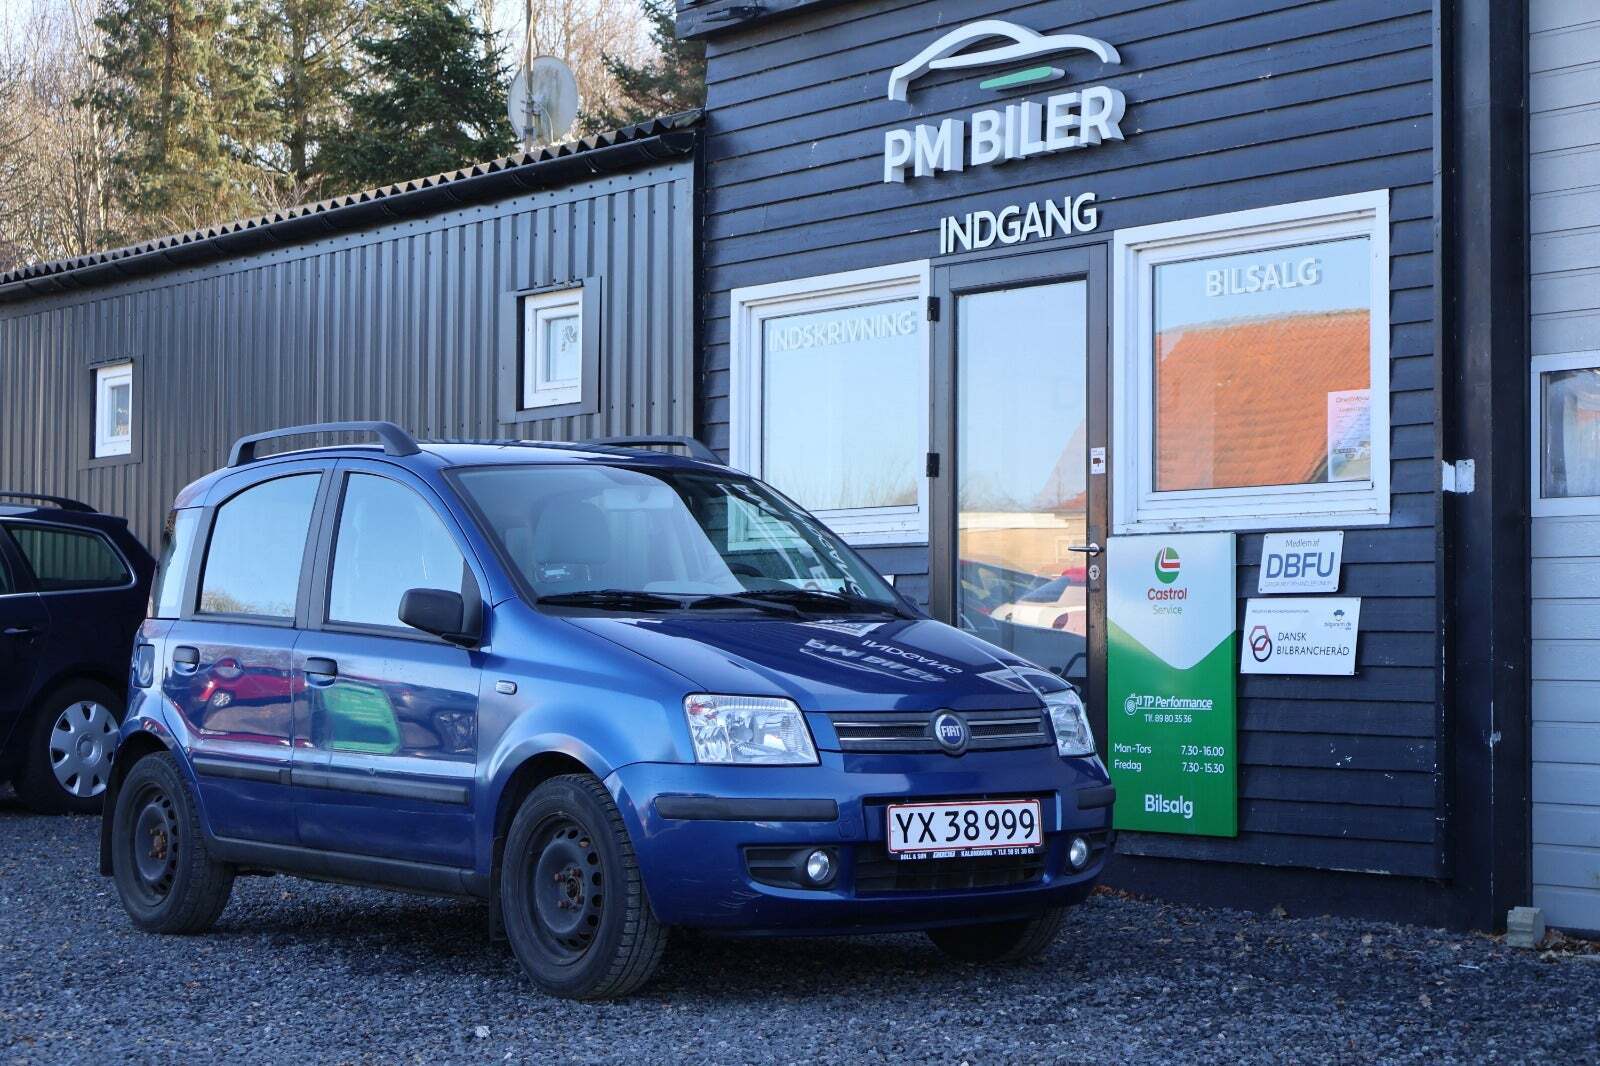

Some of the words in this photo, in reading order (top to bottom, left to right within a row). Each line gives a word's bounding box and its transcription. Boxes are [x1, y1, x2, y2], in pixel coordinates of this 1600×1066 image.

[884, 117, 965, 183] PM
[971, 85, 1126, 167] BILER
[940, 192, 1098, 255] INDGANG
[1205, 256, 1321, 297] BILSALG
[768, 310, 918, 352] INDSKRIVNING
[1266, 552, 1335, 579] DBFU
[1147, 587, 1188, 601] Castrol
[1152, 604, 1183, 615] Service
[1277, 632, 1307, 642] DANSK
[1276, 643, 1350, 656] BILBRANCHERÅD
[1155, 696, 1213, 709] Performance
[940, 725, 960, 737] FIAT
[1114, 759, 1142, 773] Fredag
[1144, 793, 1194, 819] Bilsalg
[895, 811, 937, 844] YX
